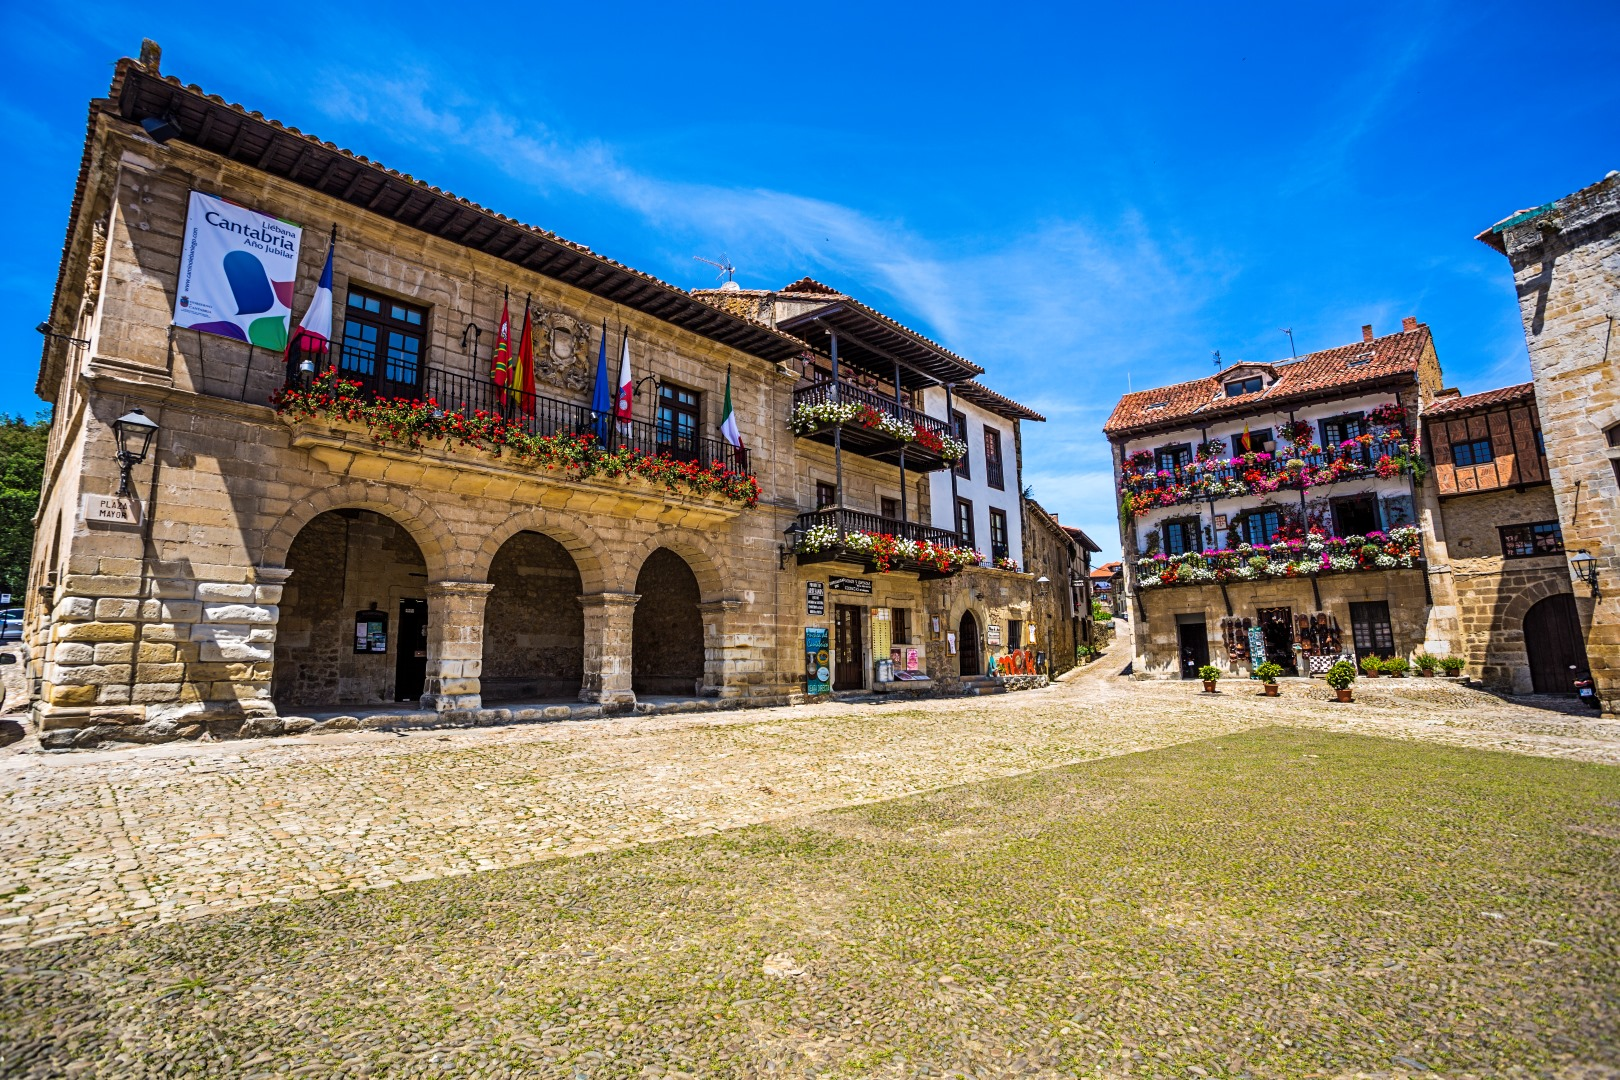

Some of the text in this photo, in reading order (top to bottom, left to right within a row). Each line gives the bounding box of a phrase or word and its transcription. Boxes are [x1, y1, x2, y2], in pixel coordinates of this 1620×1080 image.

[205, 211, 295, 252] Cantabria
[262, 221, 296, 239] Liébana
[244, 238, 294, 260] Año Jubilar
[99, 509, 127, 519] MAYOR
[100, 500, 128, 510] PLAZA
